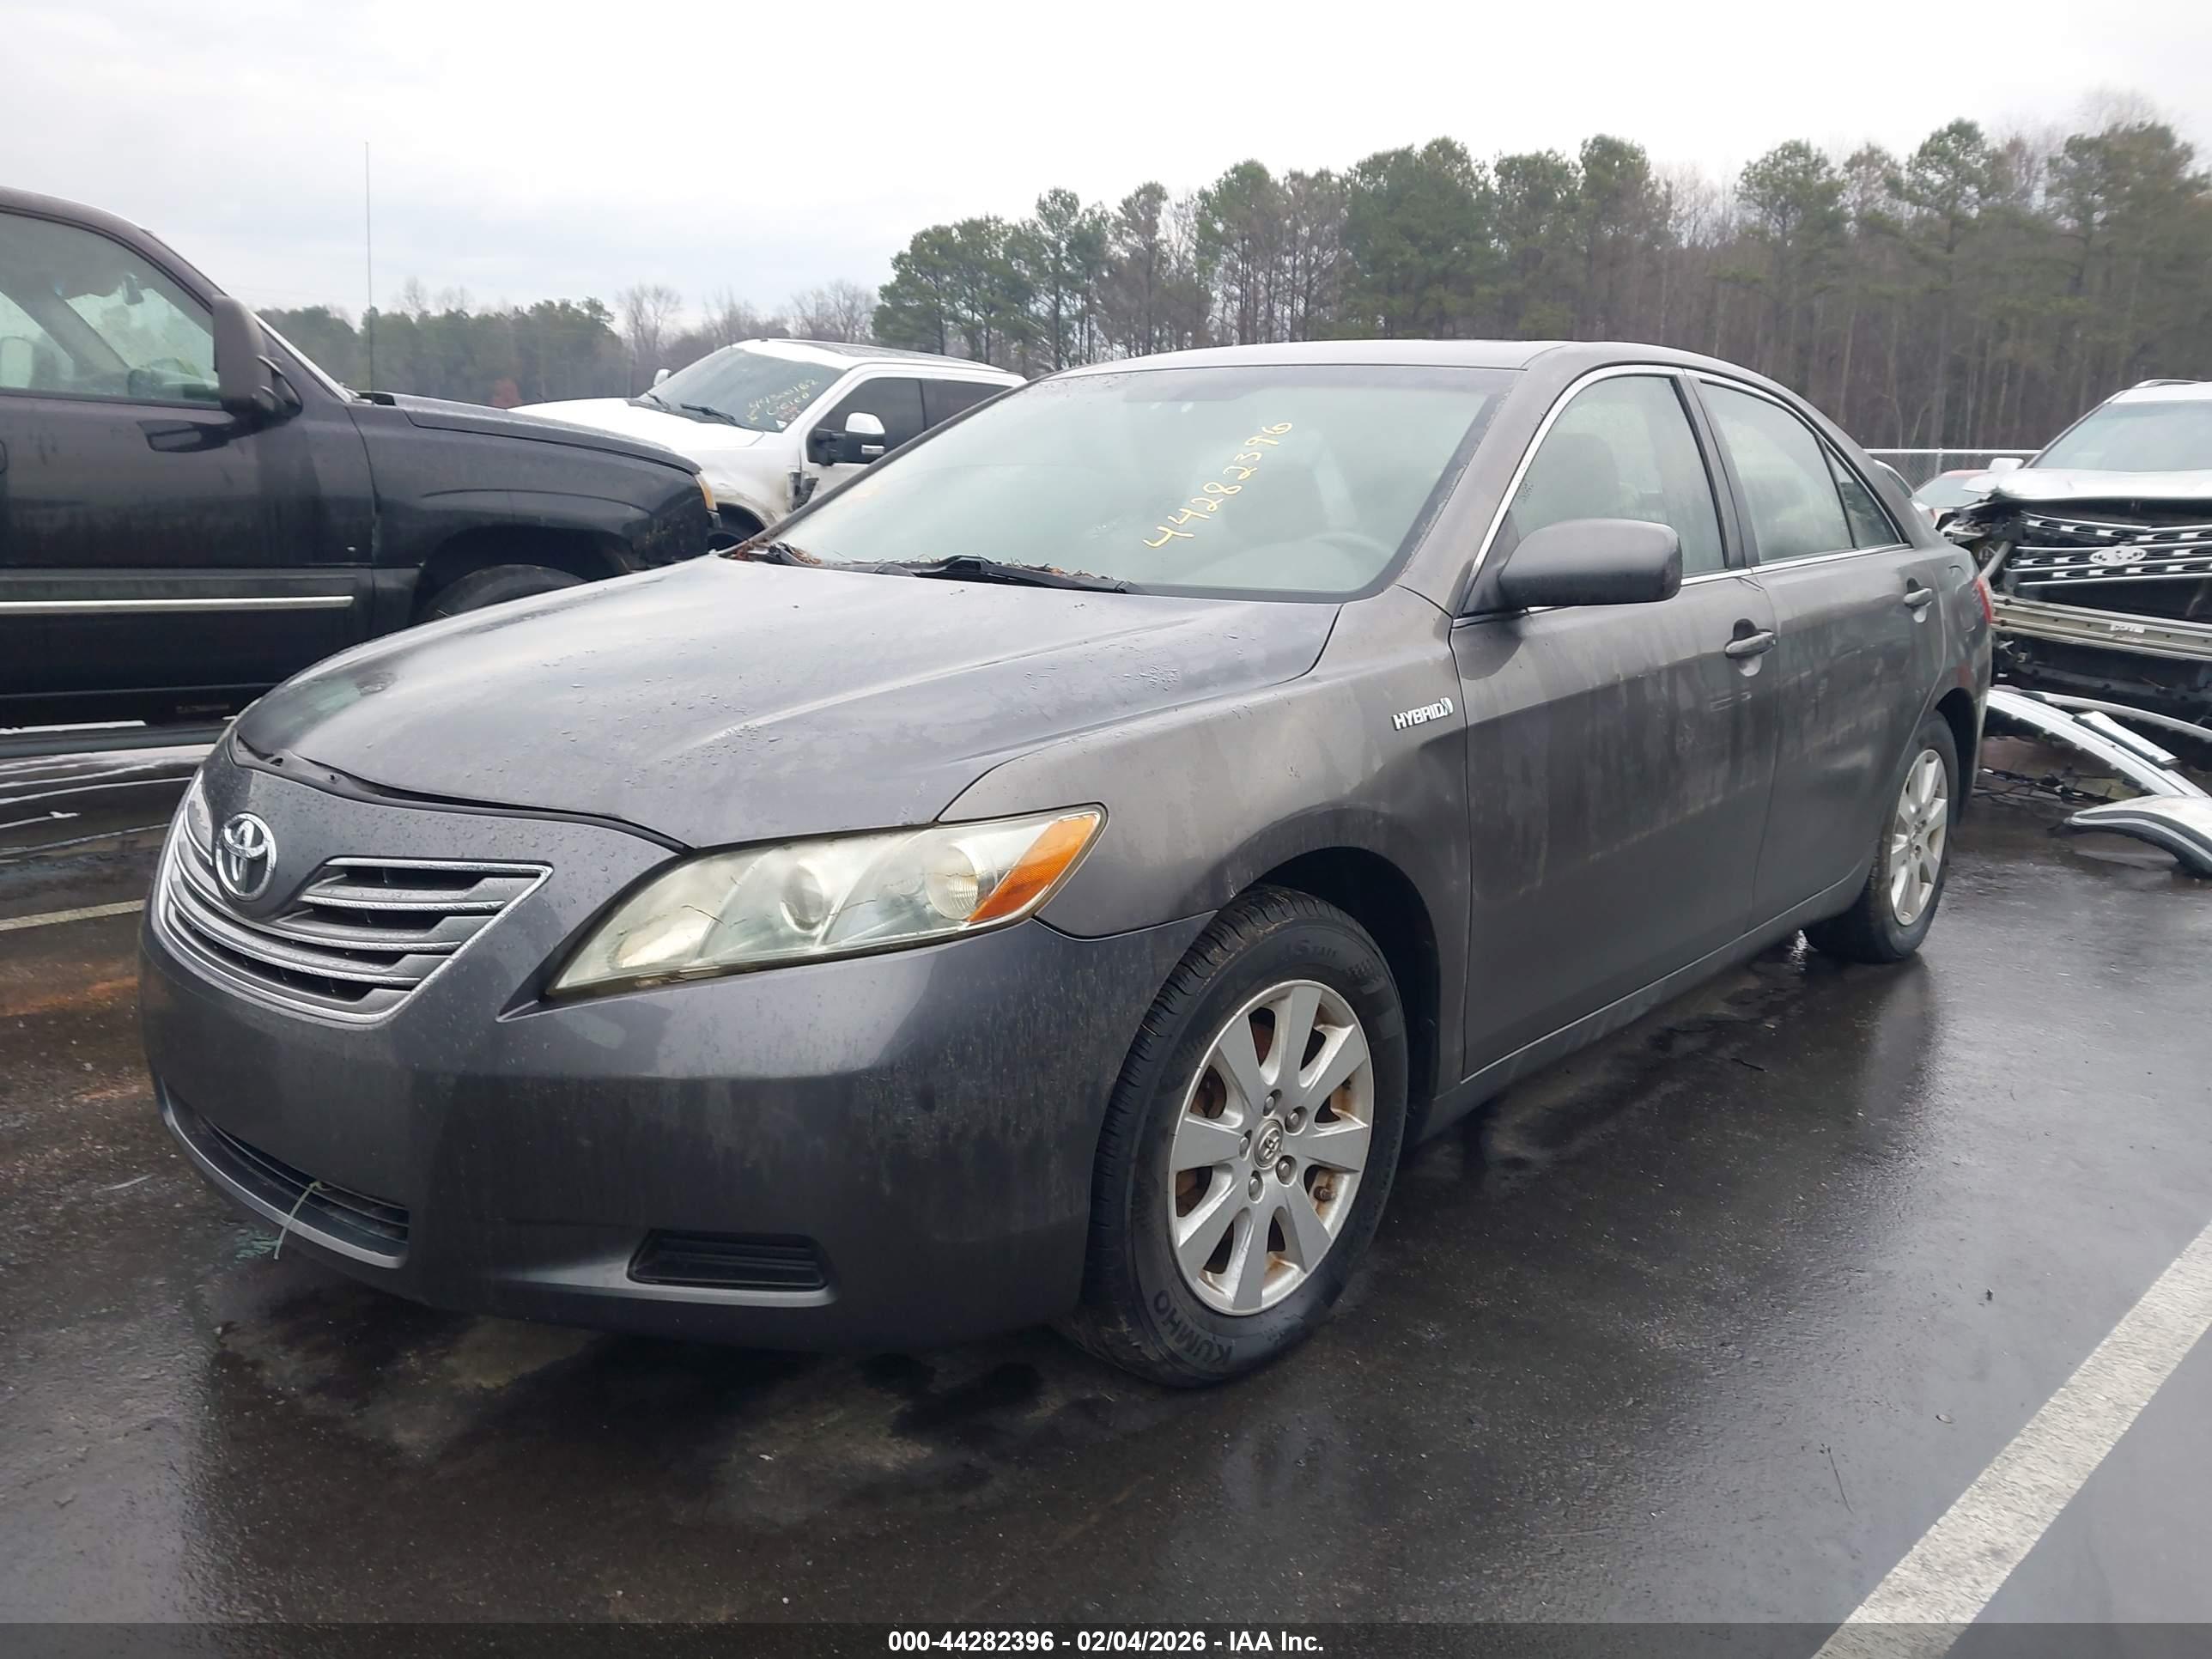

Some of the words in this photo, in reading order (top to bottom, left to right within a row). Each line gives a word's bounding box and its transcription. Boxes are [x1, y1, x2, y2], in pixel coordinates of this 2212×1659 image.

[1142, 422, 1293, 549] 44282396
[1392, 702, 1446, 731] HYBRID
[1152, 1289, 1235, 1367] KUMHO
